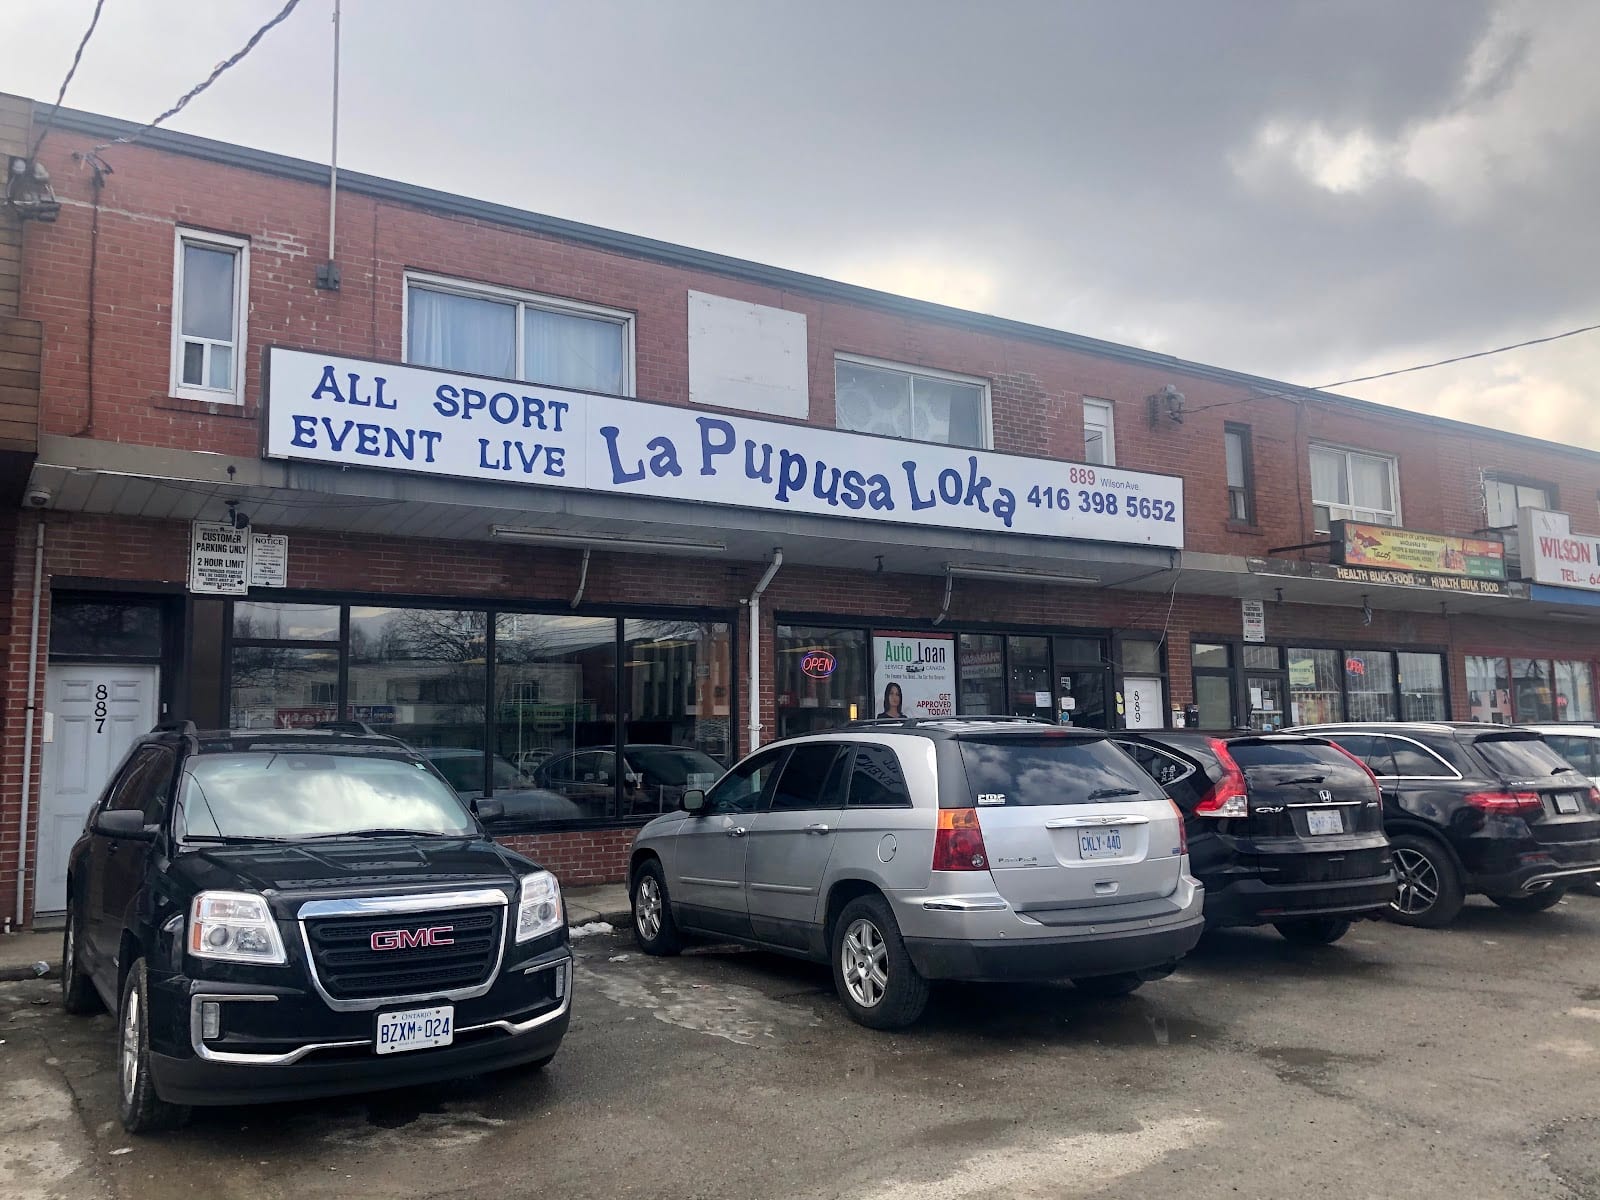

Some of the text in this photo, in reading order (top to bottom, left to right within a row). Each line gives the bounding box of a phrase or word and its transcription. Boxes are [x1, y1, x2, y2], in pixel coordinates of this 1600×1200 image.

[312, 366, 570, 433] ALL SPORT
[291, 415, 566, 478] EVENT LIVE
[600, 416, 1016, 528] La Pupusa Loka
[1069, 467, 1096, 486] 889
[1100, 479, 1125, 489] Wilson
[1027, 485, 1176, 522] 416 398 5652
[196, 542, 247, 555] PARKING ONLY
[202, 532, 242, 544] CUSTOMER
[255, 537, 284, 546] NOTICE
[1539, 536, 1591, 564] WILSON
[197, 557, 245, 569] 2 HOUR LIMIT
[1337, 567, 1368, 581] HEALTH
[1369, 571, 1391, 583] BULK
[1393, 573, 1415, 585] FOOD
[1461, 579, 1479, 591] BULK
[1480, 581, 1499, 593] FOOD
[885, 640, 912, 663] Auto
[917, 641, 946, 664] Loan
[803, 657, 833, 672] OPEN
[916, 700, 952, 709] APPROVED
[938, 693, 952, 701] GET
[1133, 690, 1141, 723] 889
[94, 684, 108, 734] 887
[927, 708, 952, 717] TODAY!
[1081, 835, 1122, 852] CKLY 440
[371, 926, 454, 950] GMC
[401, 1012, 432, 1021] ONTARIO
[381, 1017, 450, 1044] BZXM 024
